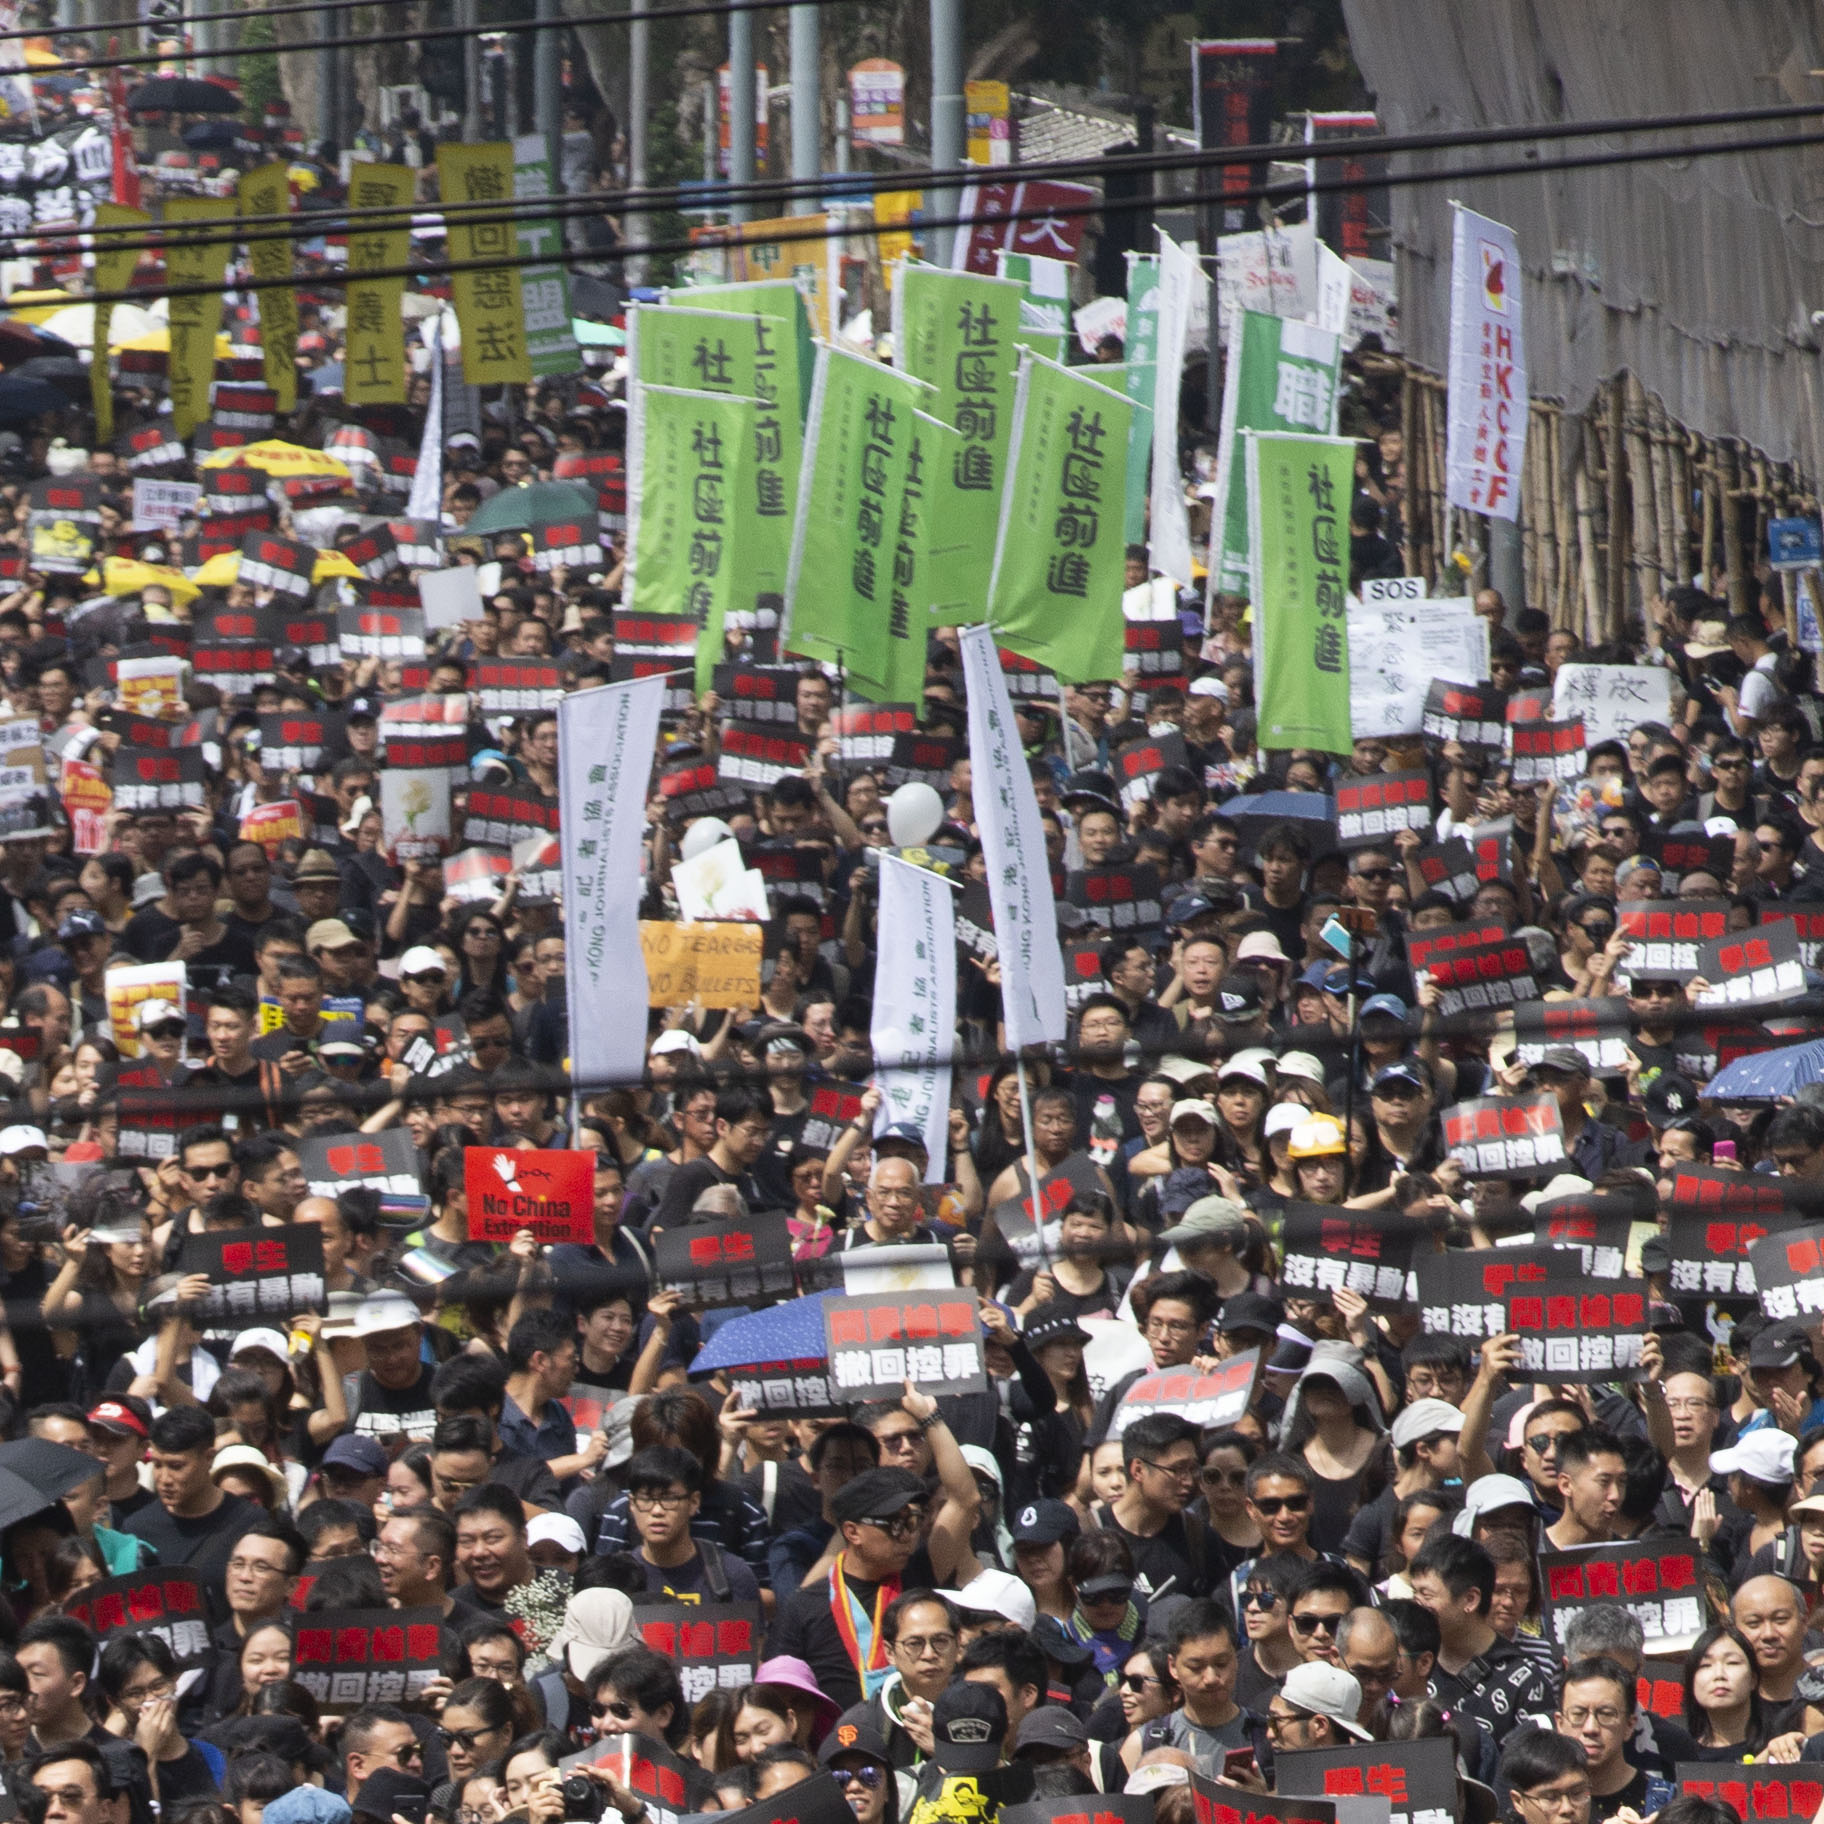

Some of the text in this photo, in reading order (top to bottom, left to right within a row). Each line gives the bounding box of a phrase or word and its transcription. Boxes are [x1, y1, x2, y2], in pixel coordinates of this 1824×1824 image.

[953, 303, 999, 492] 社區前進
[1047, 406, 1108, 600] 社區前進
[1310, 464, 1349, 674] 社區前進
[1370, 578, 1419, 600] SOS
[1716, 935, 1774, 974] 學生
[678, 973, 758, 995] BULLETS
[483, 1194, 571, 1217] No China
[1510, 1294, 1646, 1332] 問責槍擊
[1548, 1555, 1697, 1601] 問責槍擊
[295, 1625, 441, 1665] 問責槍擊
